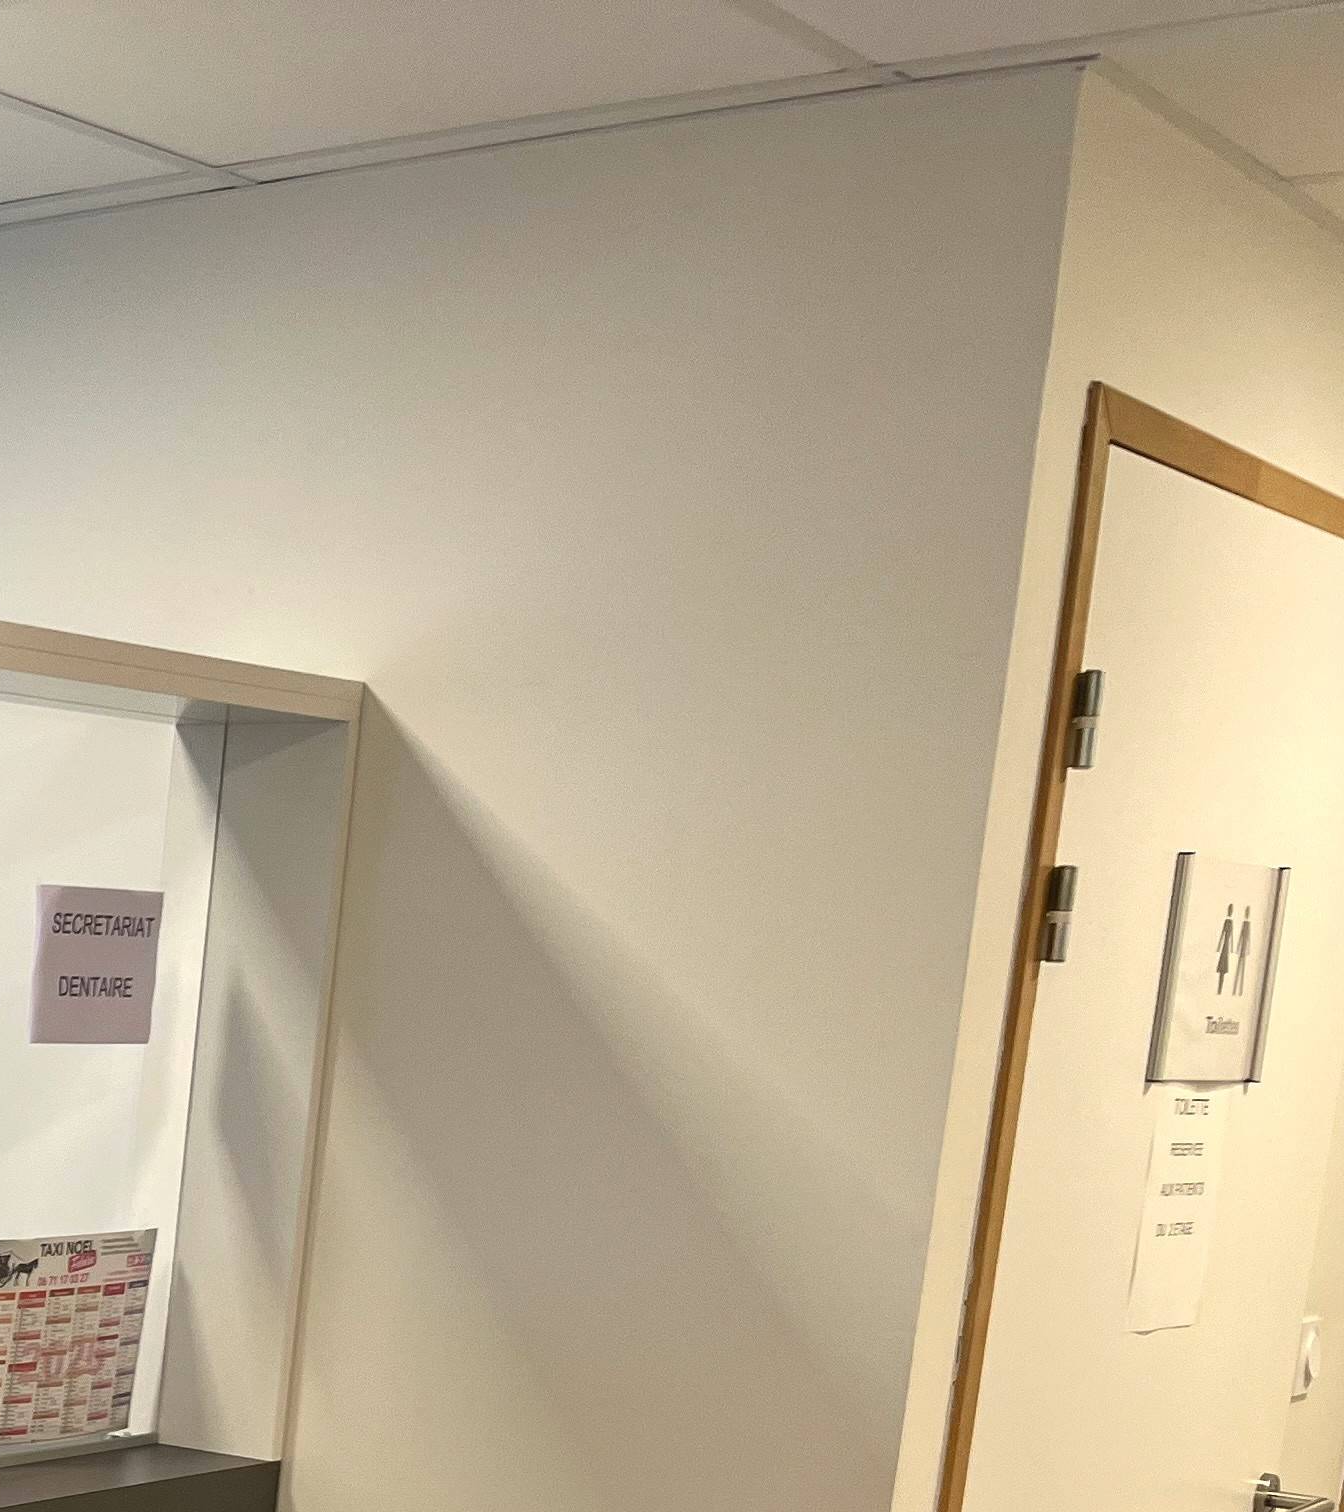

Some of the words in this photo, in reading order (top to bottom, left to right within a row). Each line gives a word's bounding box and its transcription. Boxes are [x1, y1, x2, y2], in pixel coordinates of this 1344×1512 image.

[52, 913, 155, 937] SECRETARIAT
[59, 976, 133, 997] DENTAIRE
[40, 1243, 64, 1257] TAXI
